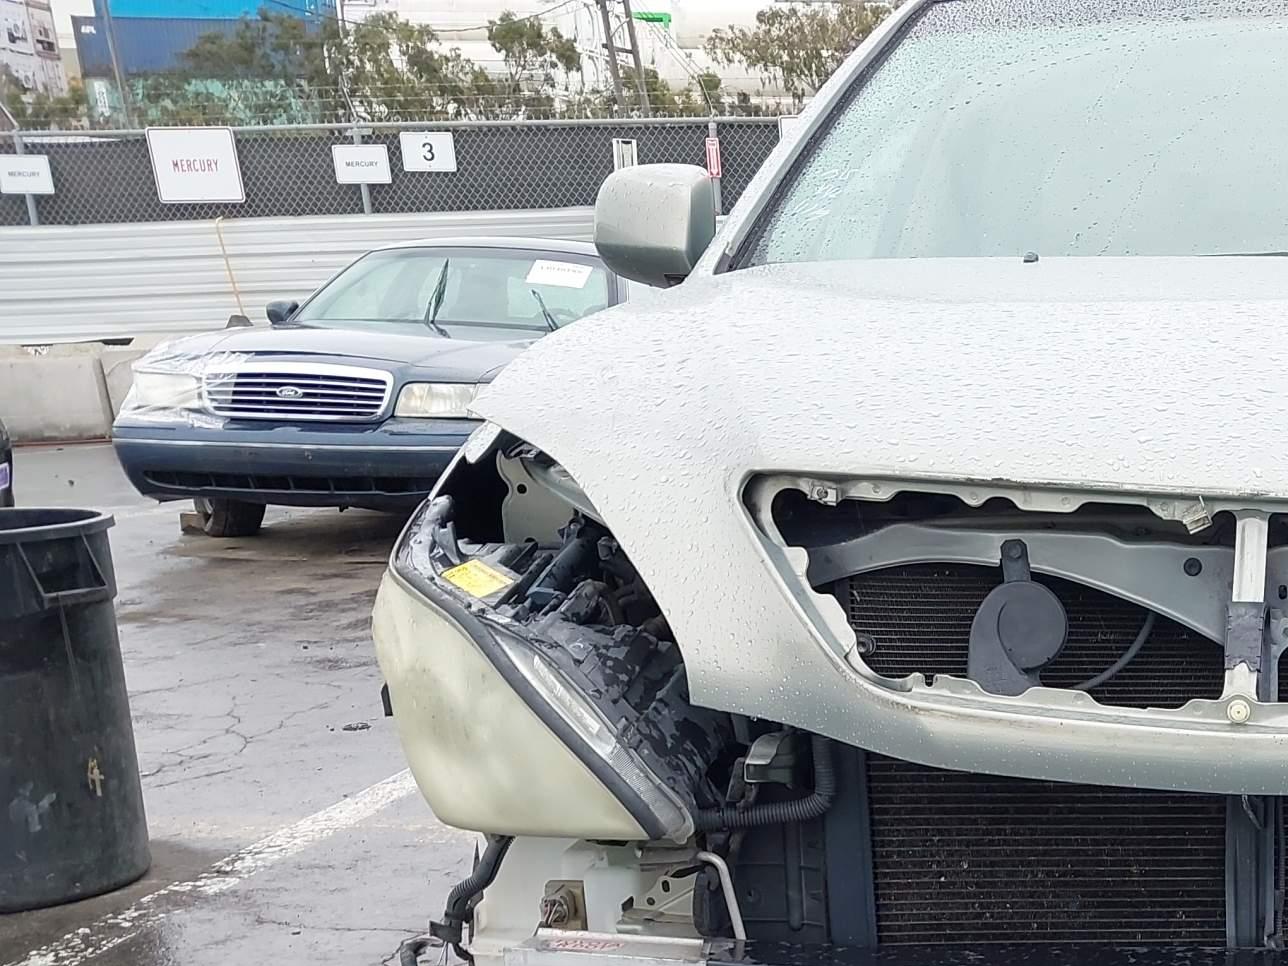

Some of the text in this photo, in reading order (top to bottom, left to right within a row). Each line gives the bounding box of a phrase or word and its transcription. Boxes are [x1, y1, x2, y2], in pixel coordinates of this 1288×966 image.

[422, 142, 435, 162] 3
[171, 159, 219, 173] MERCURY
[345, 160, 379, 168] MERCURY
[7, 170, 40, 178] MERCURY
